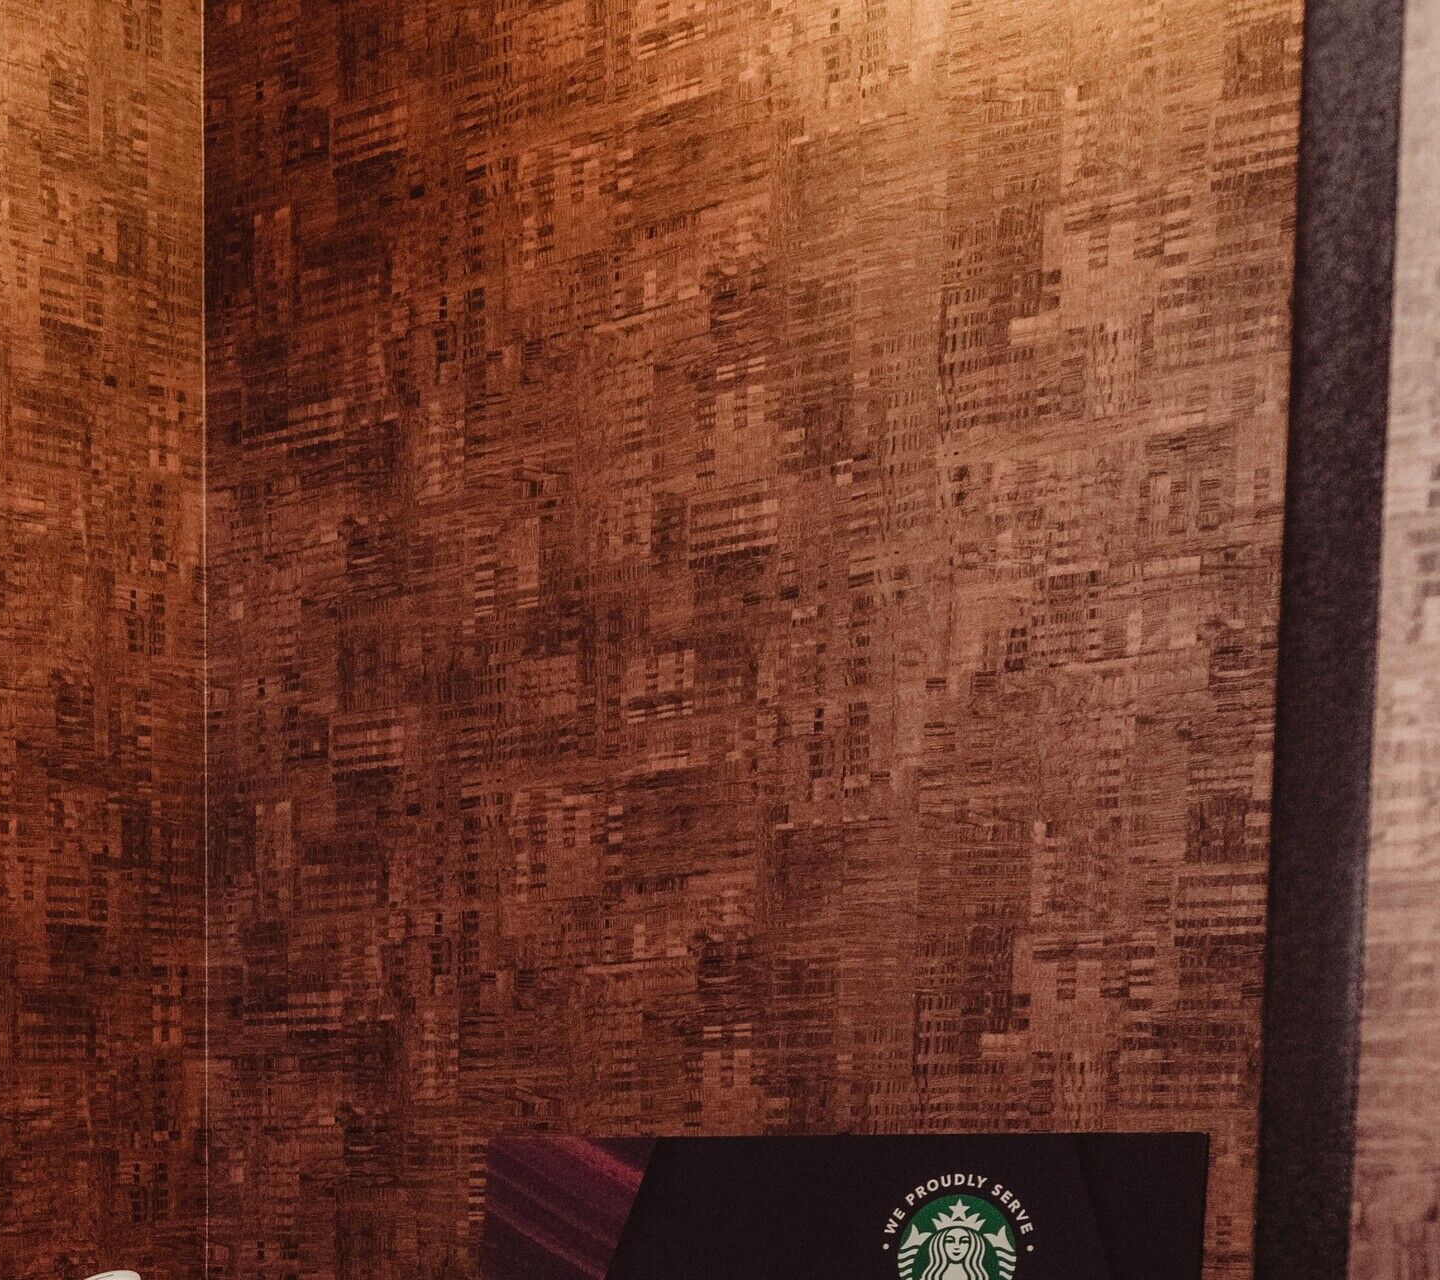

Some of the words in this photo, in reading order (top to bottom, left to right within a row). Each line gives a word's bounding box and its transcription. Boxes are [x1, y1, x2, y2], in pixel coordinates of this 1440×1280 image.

[884, 1208, 906, 1235] WE
[905, 1173, 988, 1206] PROUDLY
[991, 1184, 1034, 1235] SERVE
